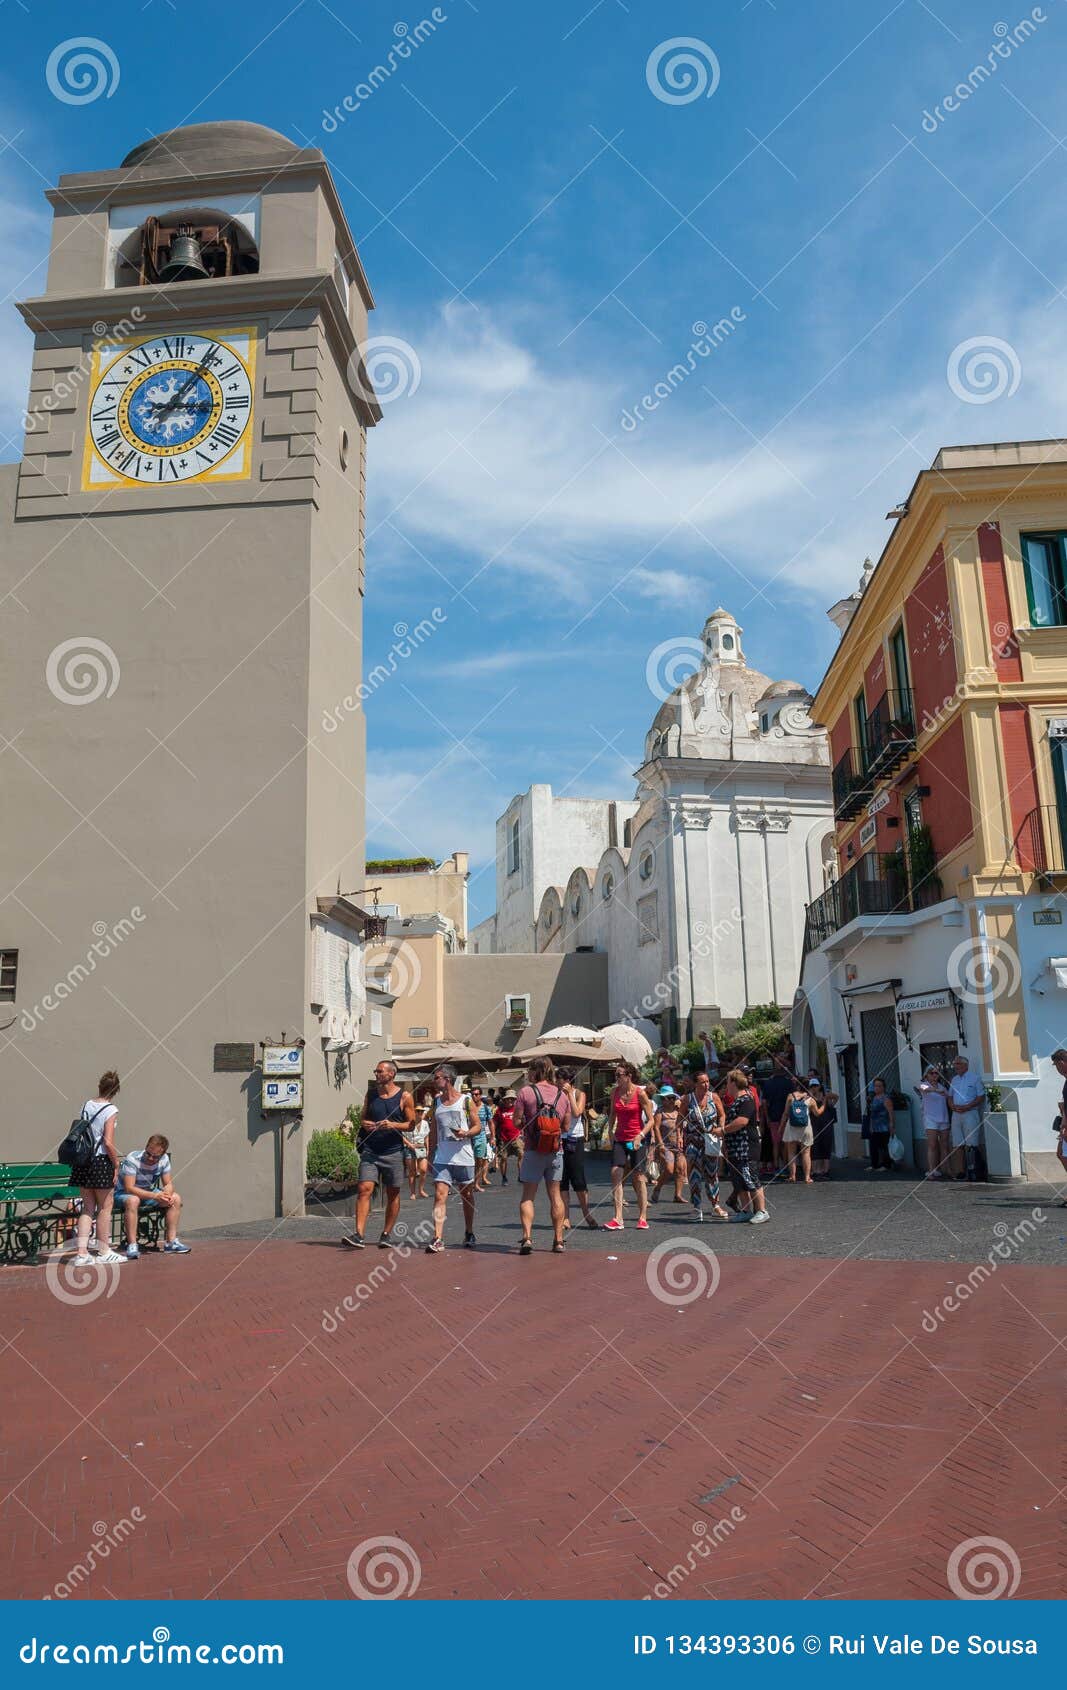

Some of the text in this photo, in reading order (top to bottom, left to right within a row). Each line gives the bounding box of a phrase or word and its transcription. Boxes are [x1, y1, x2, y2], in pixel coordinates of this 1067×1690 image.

[128, 347, 152, 367] XI
[163, 337, 186, 358] XII
[218, 364, 242, 381] II
[225, 395, 250, 410] III
[96, 429, 122, 460] VIII
[211, 422, 241, 448] IIII
[118, 450, 142, 478] VII
[159, 458, 179, 481] VI
[195, 450, 215, 468] V
